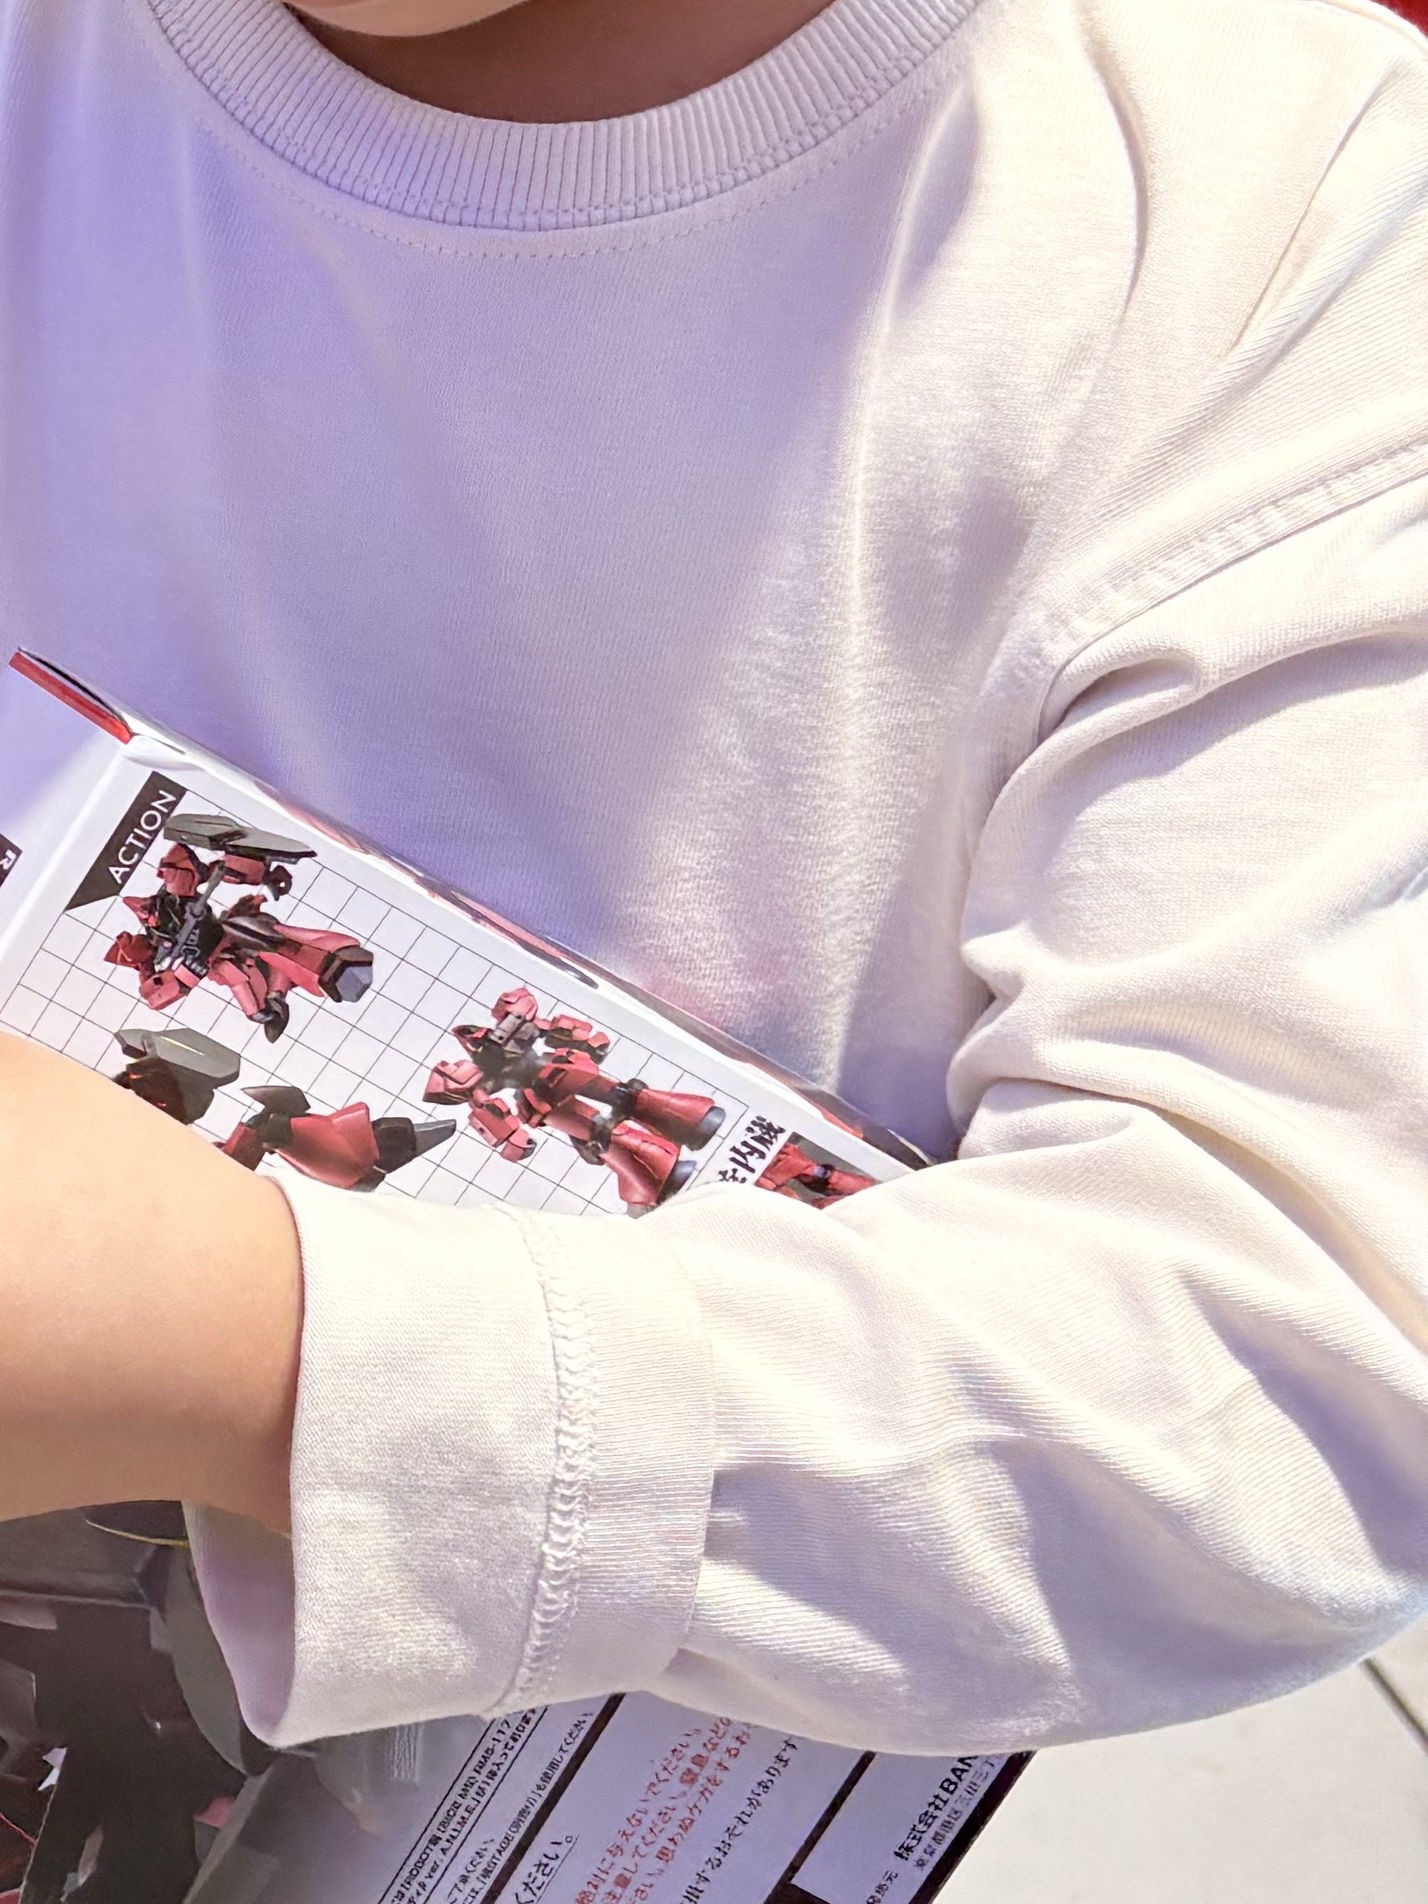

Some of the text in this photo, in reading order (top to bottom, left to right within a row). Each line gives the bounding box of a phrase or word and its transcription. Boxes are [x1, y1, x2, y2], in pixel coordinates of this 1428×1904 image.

[108, 790, 177, 885] ACTION
[892, 1746, 979, 1863] 株式会社BAN
